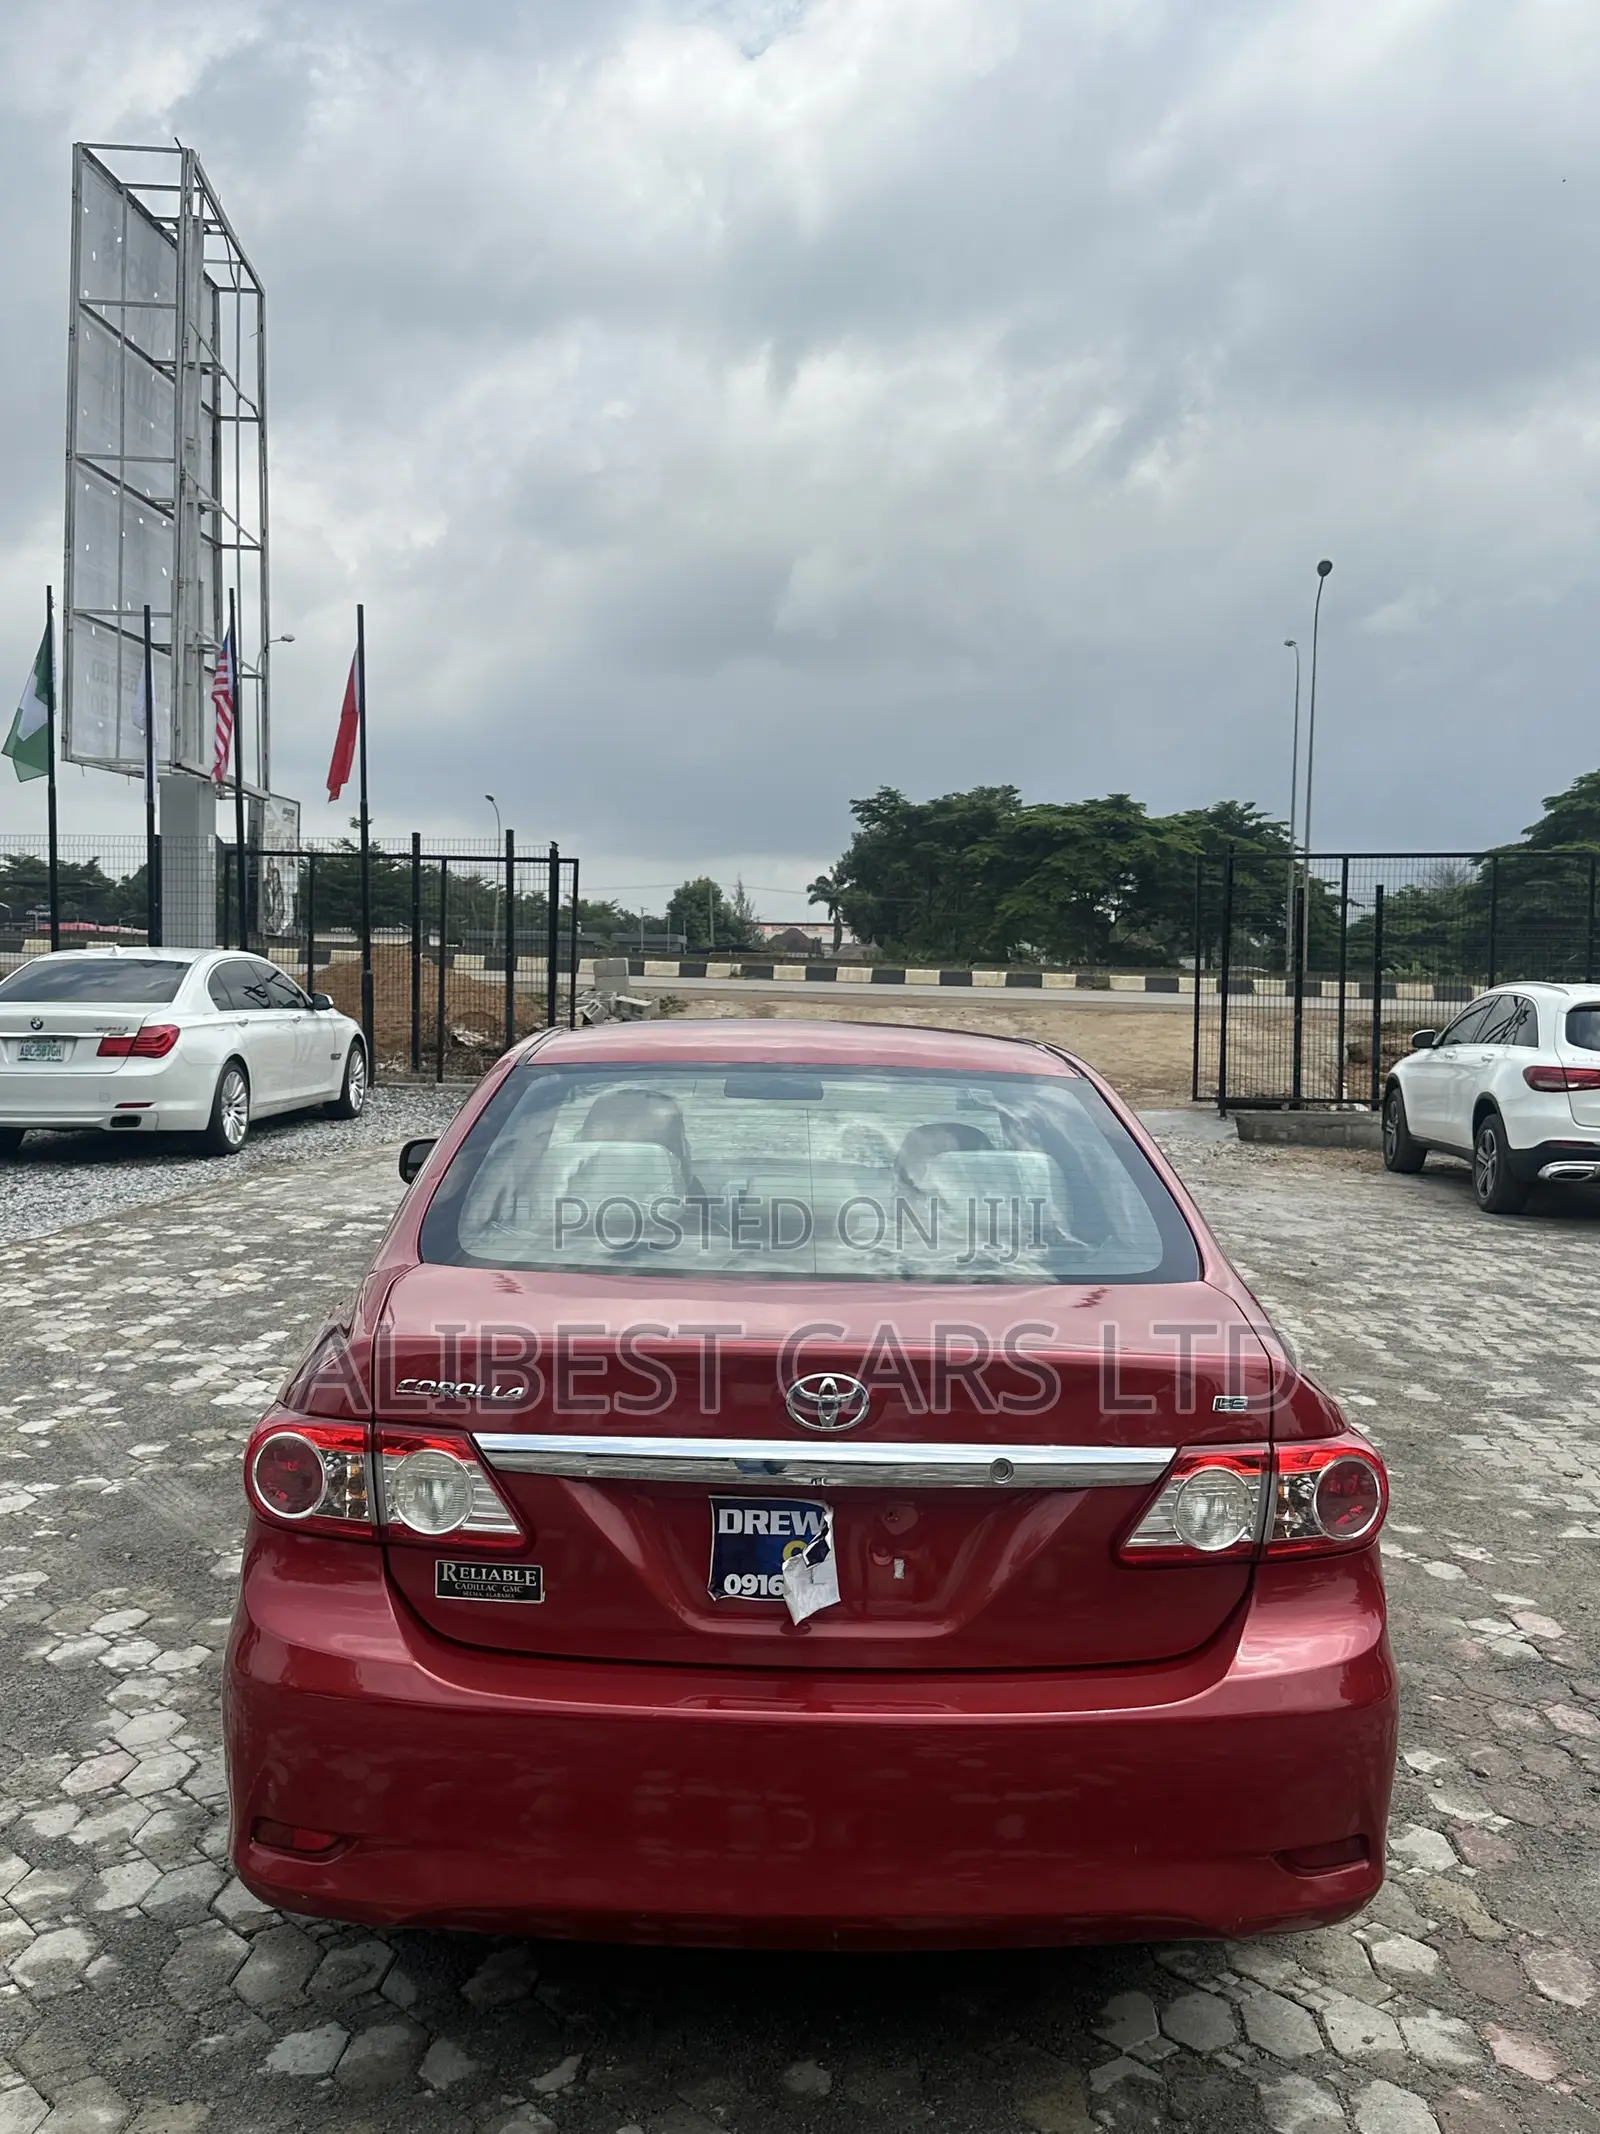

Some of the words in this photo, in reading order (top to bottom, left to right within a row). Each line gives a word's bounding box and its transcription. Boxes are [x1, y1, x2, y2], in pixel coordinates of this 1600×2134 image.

[396, 1378, 524, 1400] COROLLA
[718, 1508, 825, 1535] DREW
[441, 1562, 537, 1586] RELIABLE
[723, 1573, 784, 1596] 0916
[454, 1582, 497, 1592] CADILLAC
[502, 1585, 524, 1593] GMC
